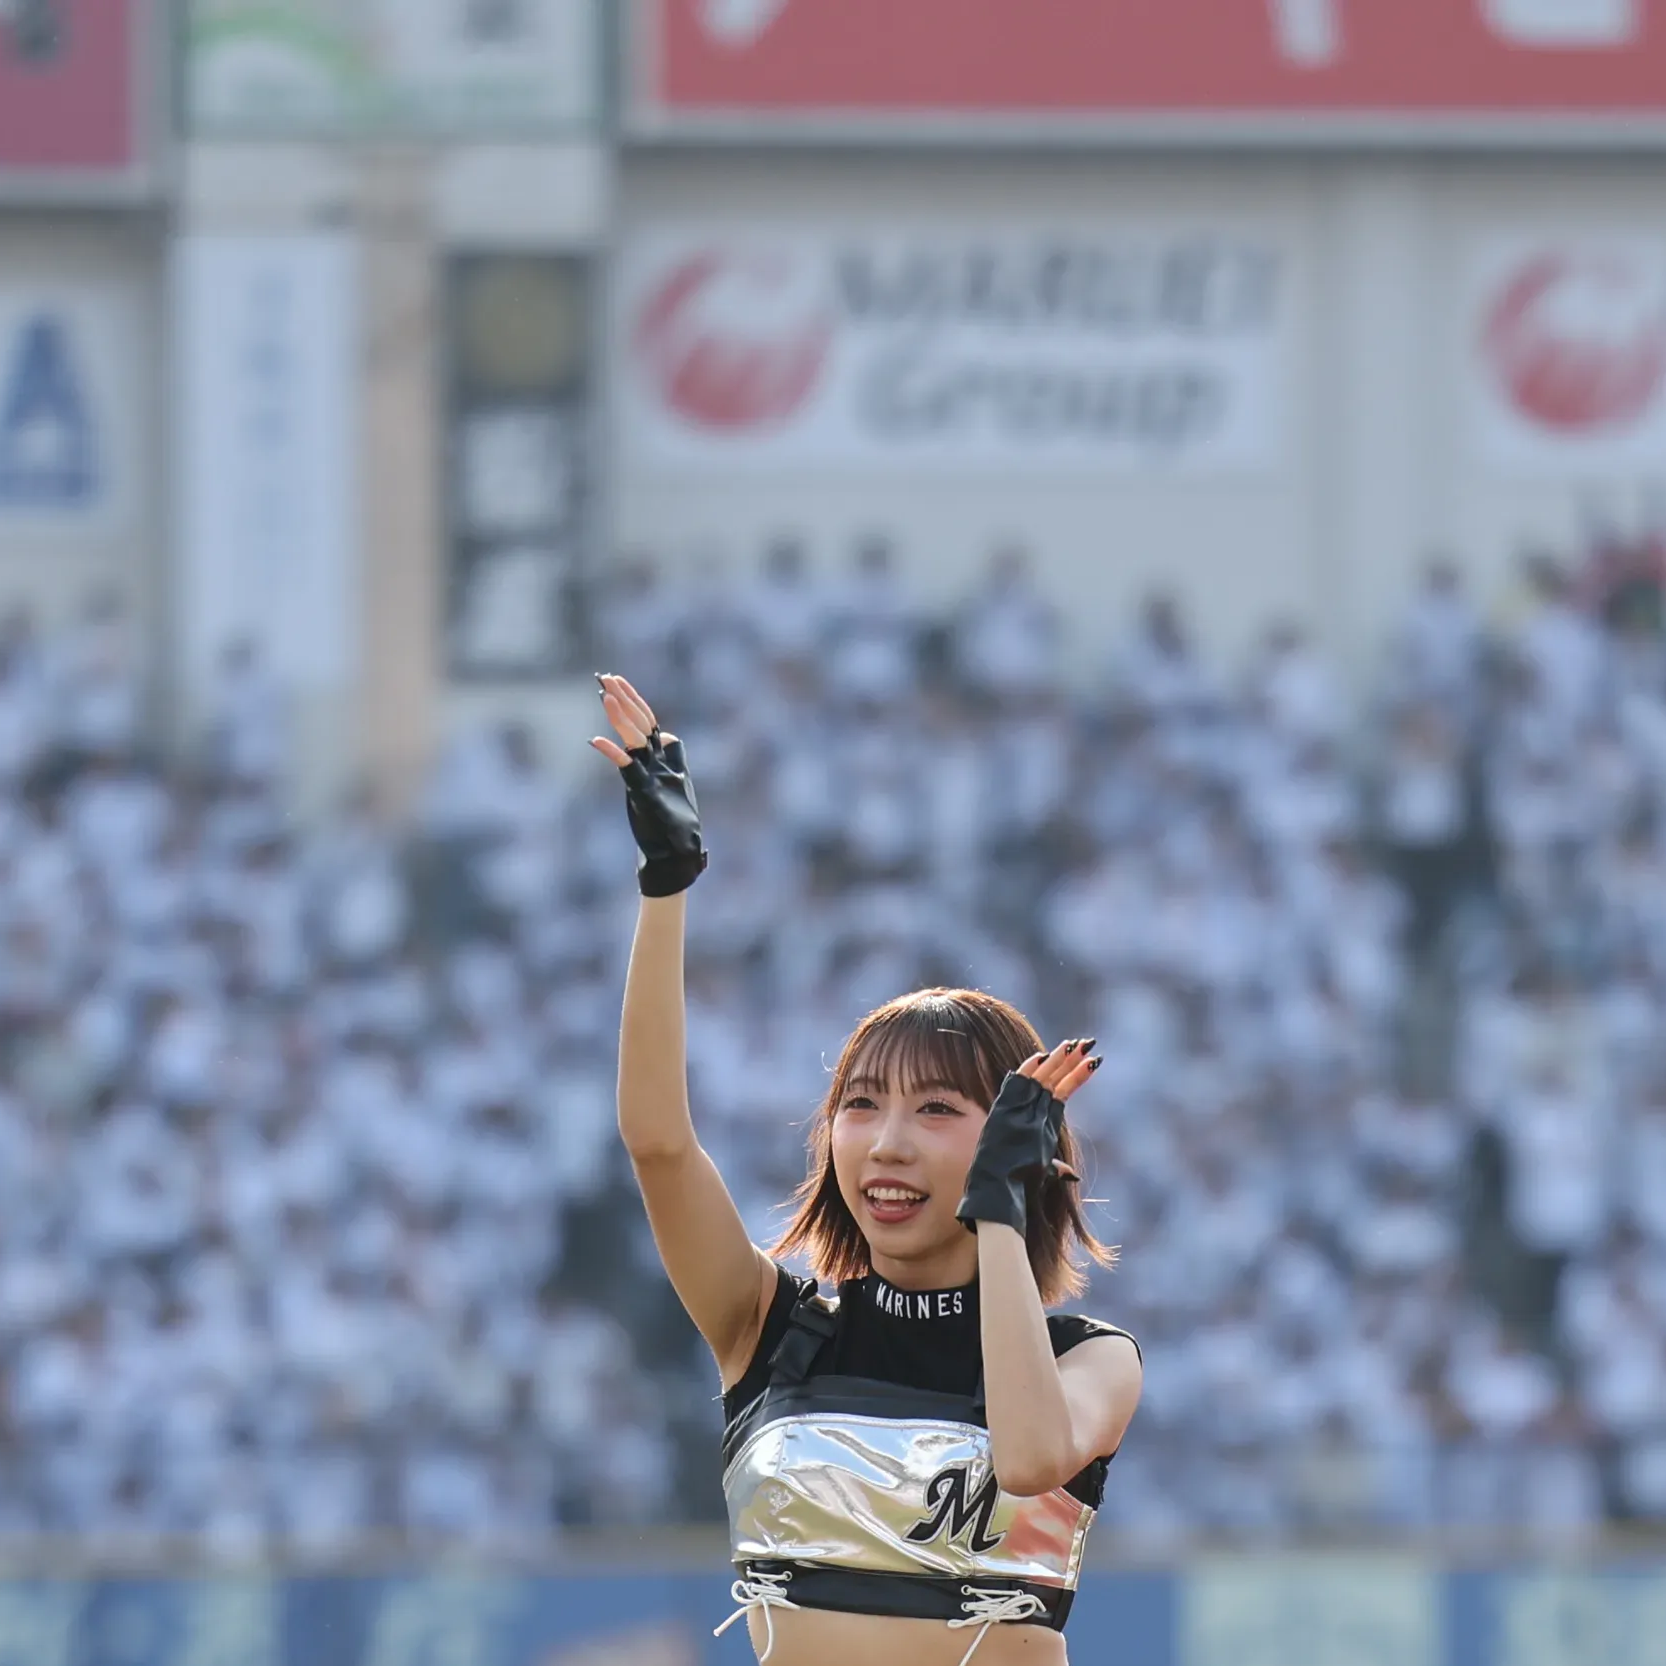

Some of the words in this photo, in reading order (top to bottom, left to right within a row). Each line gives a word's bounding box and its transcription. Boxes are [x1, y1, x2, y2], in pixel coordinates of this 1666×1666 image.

[853, 334, 1229, 460] Group
[876, 1282, 963, 1319] MARINES
[903, 1462, 1007, 1555] M
